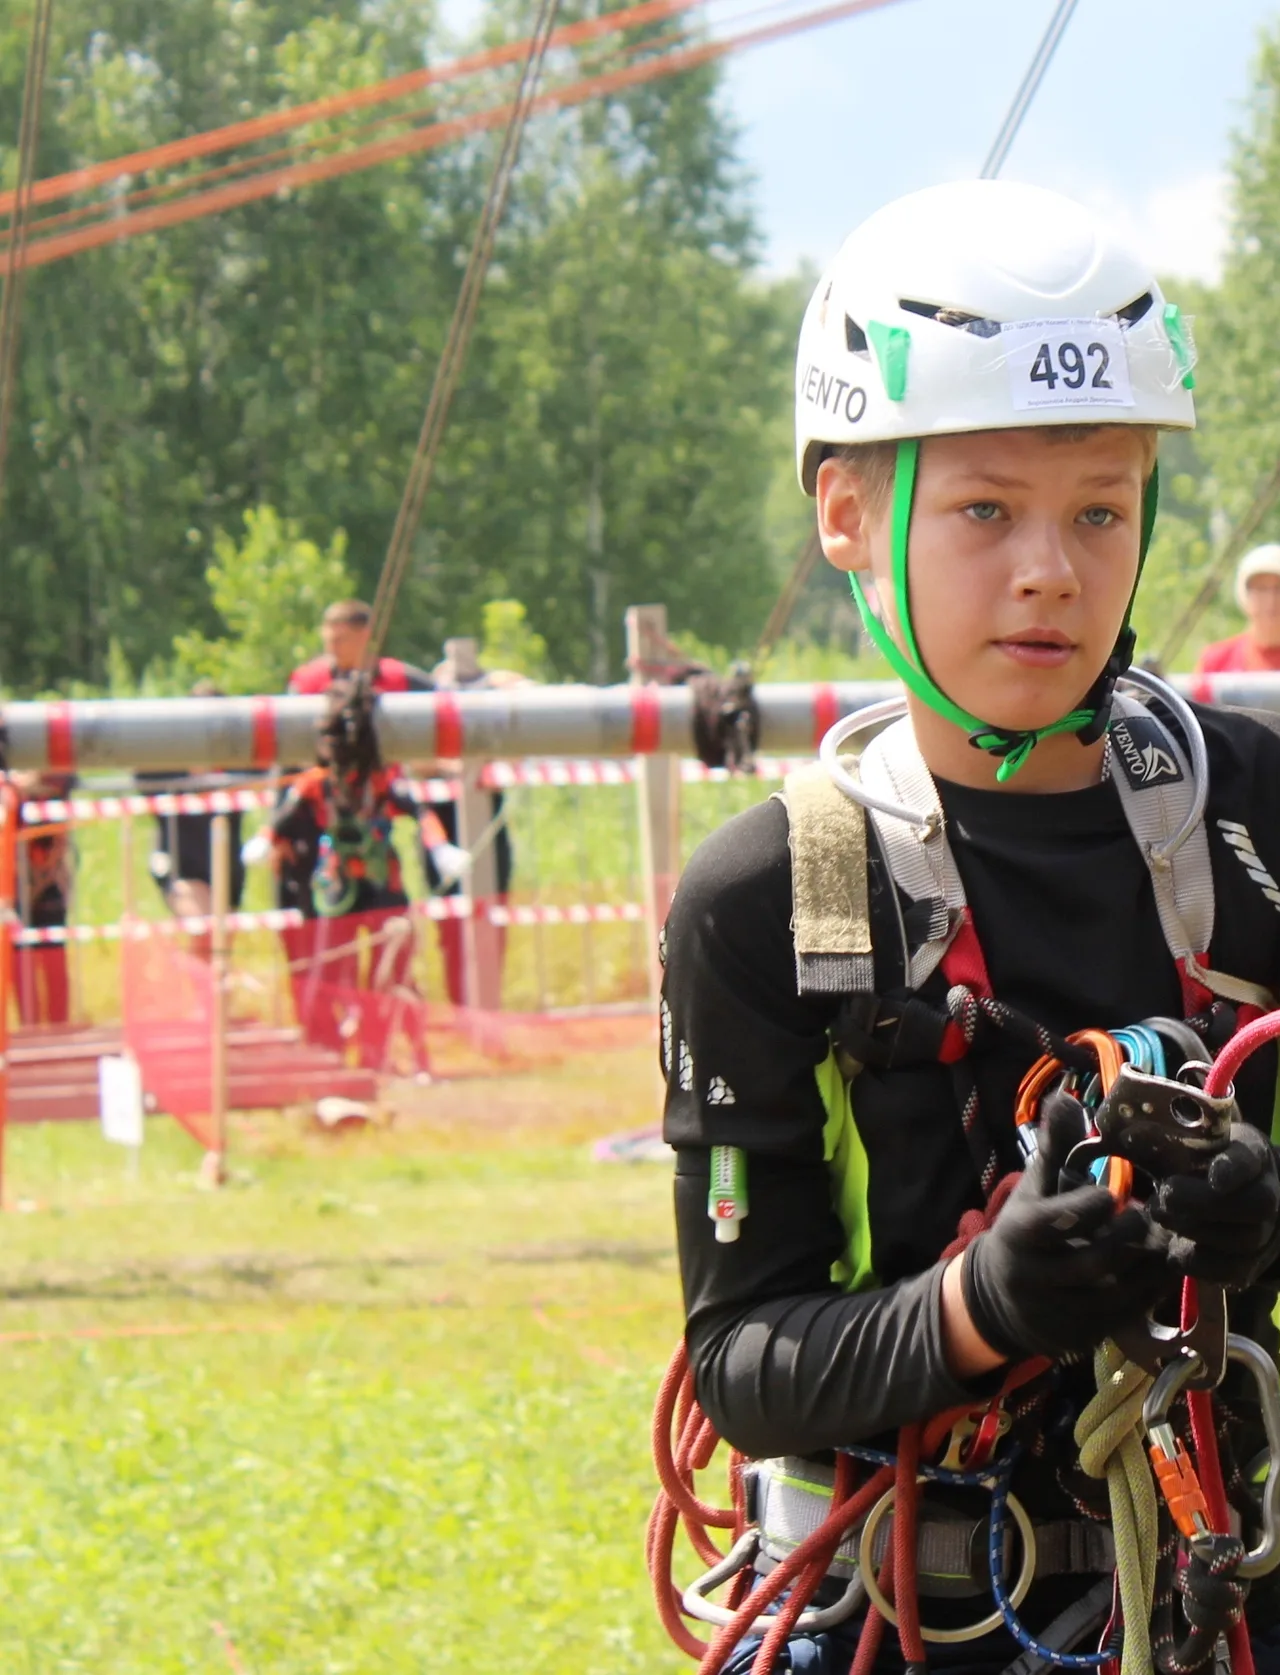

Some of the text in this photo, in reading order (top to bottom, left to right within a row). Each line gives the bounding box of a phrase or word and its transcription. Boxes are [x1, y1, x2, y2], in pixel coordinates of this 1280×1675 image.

[1030, 342, 1113, 389] 492
[801, 363, 867, 424] VENTO
[1113, 722, 1146, 775] VENTO
